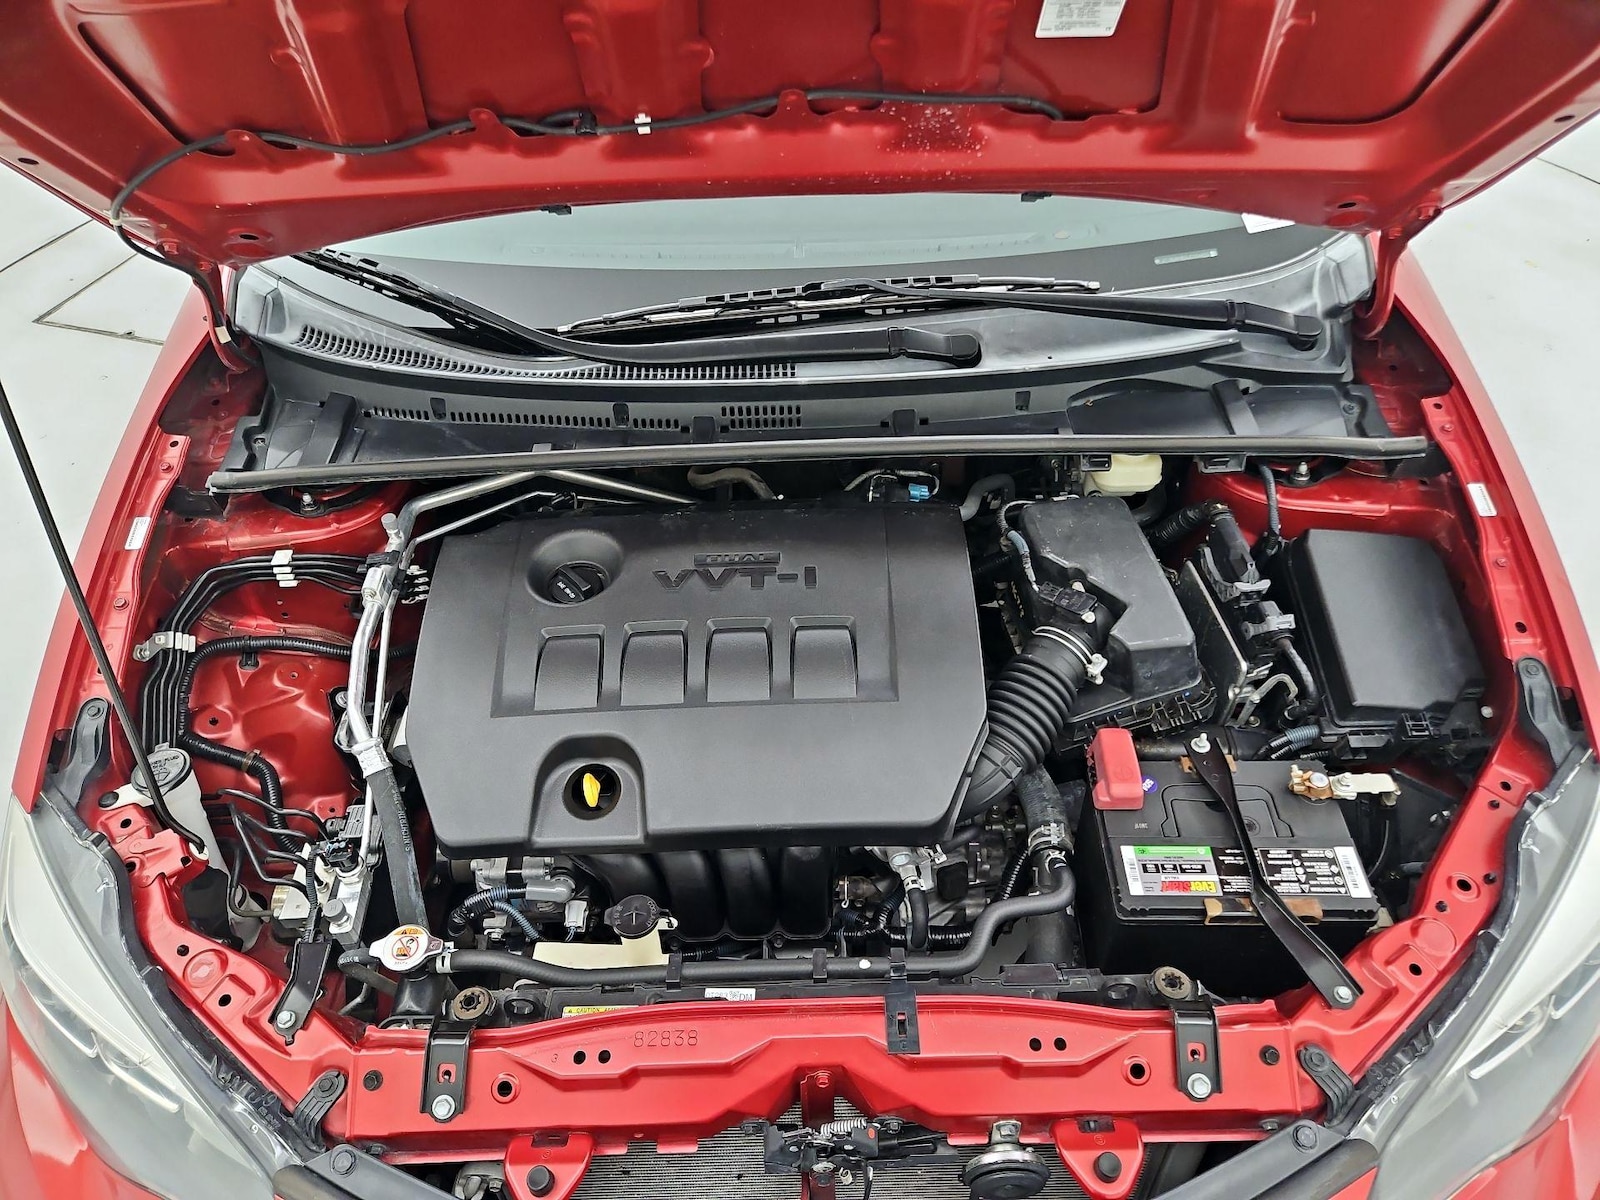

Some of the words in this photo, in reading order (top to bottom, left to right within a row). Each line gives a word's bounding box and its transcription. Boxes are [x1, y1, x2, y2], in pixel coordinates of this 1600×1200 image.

[700, 552, 774, 565] DUAL
[1161, 880, 1217, 893] EverStart
[633, 1029, 698, 1048] 82838
